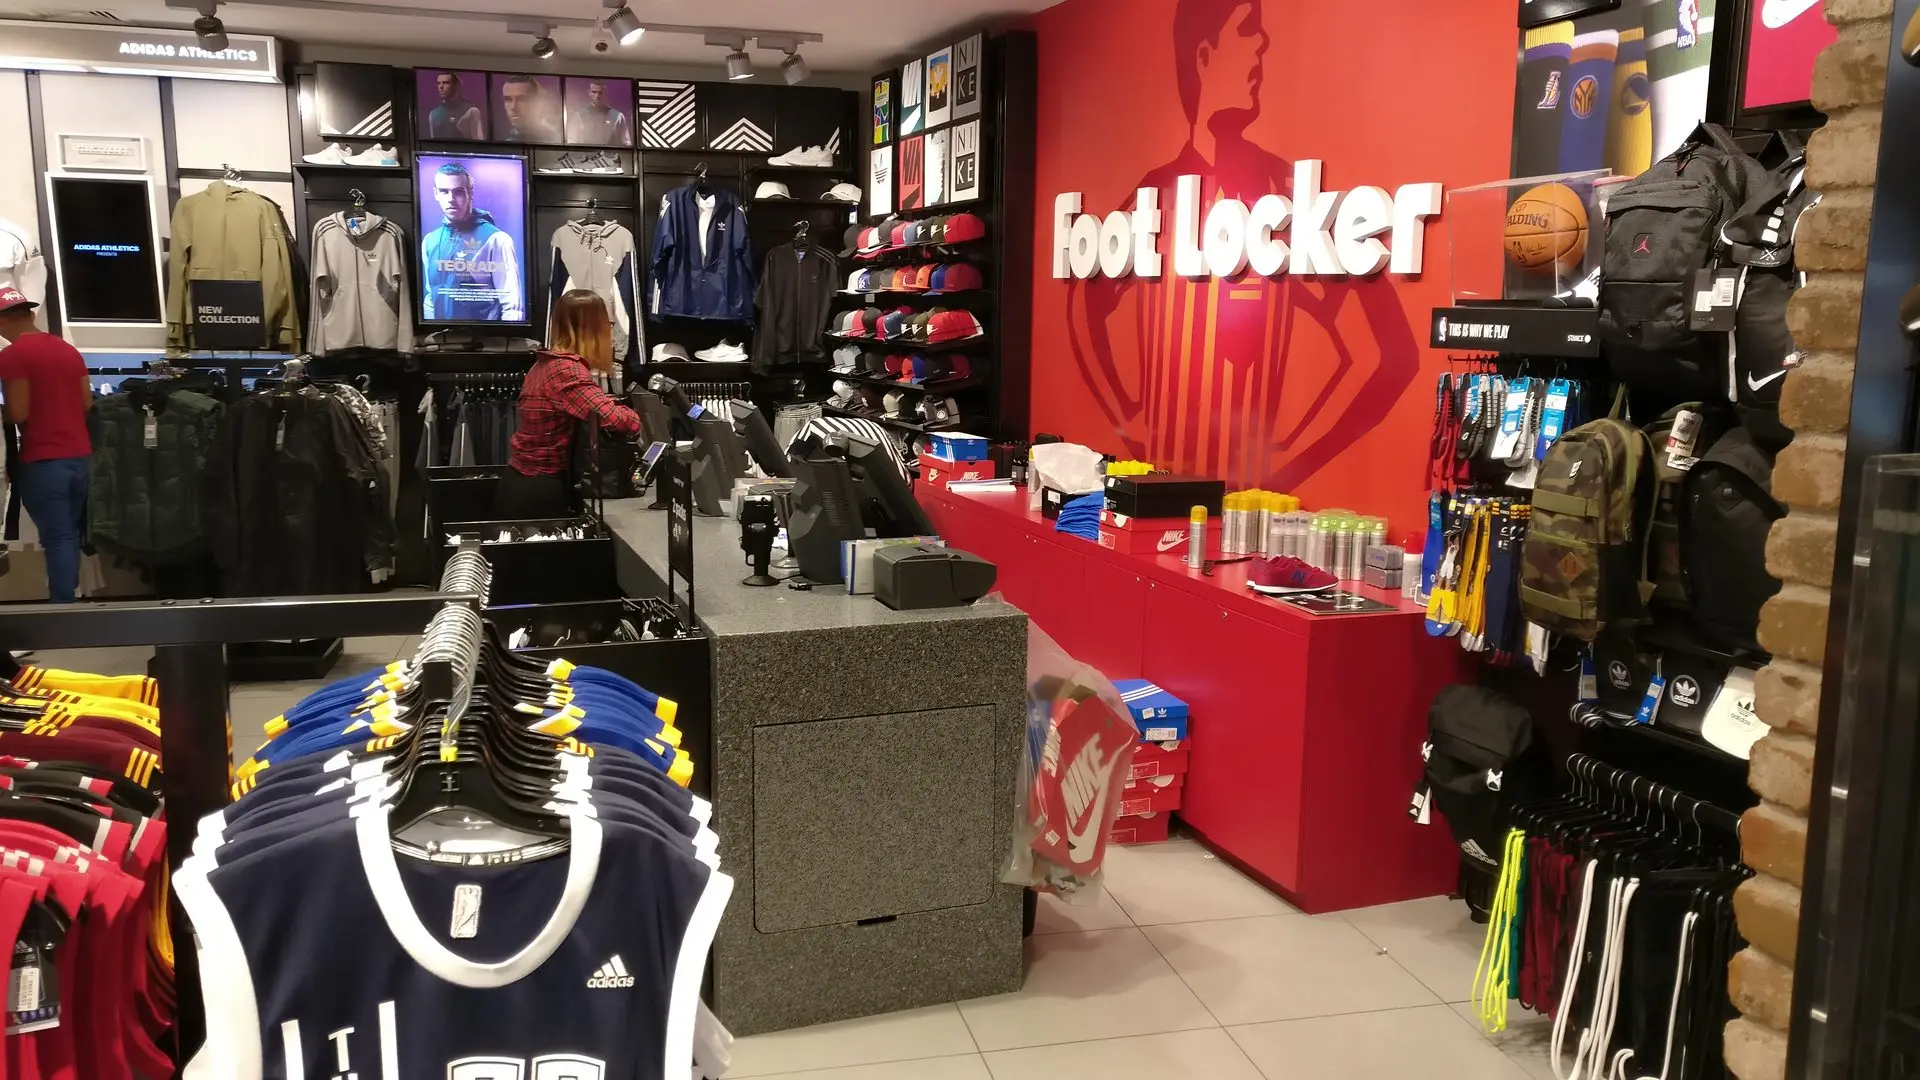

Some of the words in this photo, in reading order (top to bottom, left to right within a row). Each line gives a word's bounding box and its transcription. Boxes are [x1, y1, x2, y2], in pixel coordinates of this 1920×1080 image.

[1677, 35, 1696, 49] NBA
[119, 42, 175, 57] ADIDAS
[178, 46, 257, 62] ATHLETICS
[1053, 187, 1161, 279] Foot
[1175, 159, 1443, 277] Locker
[1505, 213, 1549, 229] ALDING
[198, 305, 223, 314] NEW
[199, 315, 260, 324] COLLECTION
[1449, 323, 1462, 337] THIS
[1462, 323, 1469, 337] IS
[1469, 323, 1483, 338] WHY
[1483, 324, 1494, 339] WE
[1494, 325, 1510, 340] PLAY
[963, 471, 980, 480] NIKE
[1163, 530, 1185, 542] NIKE
[1673, 694, 1695, 705] adidas
[1729, 712, 1752, 727] adidas
[1061, 733, 1104, 829] NIKE
[587, 975, 635, 988] adidas
